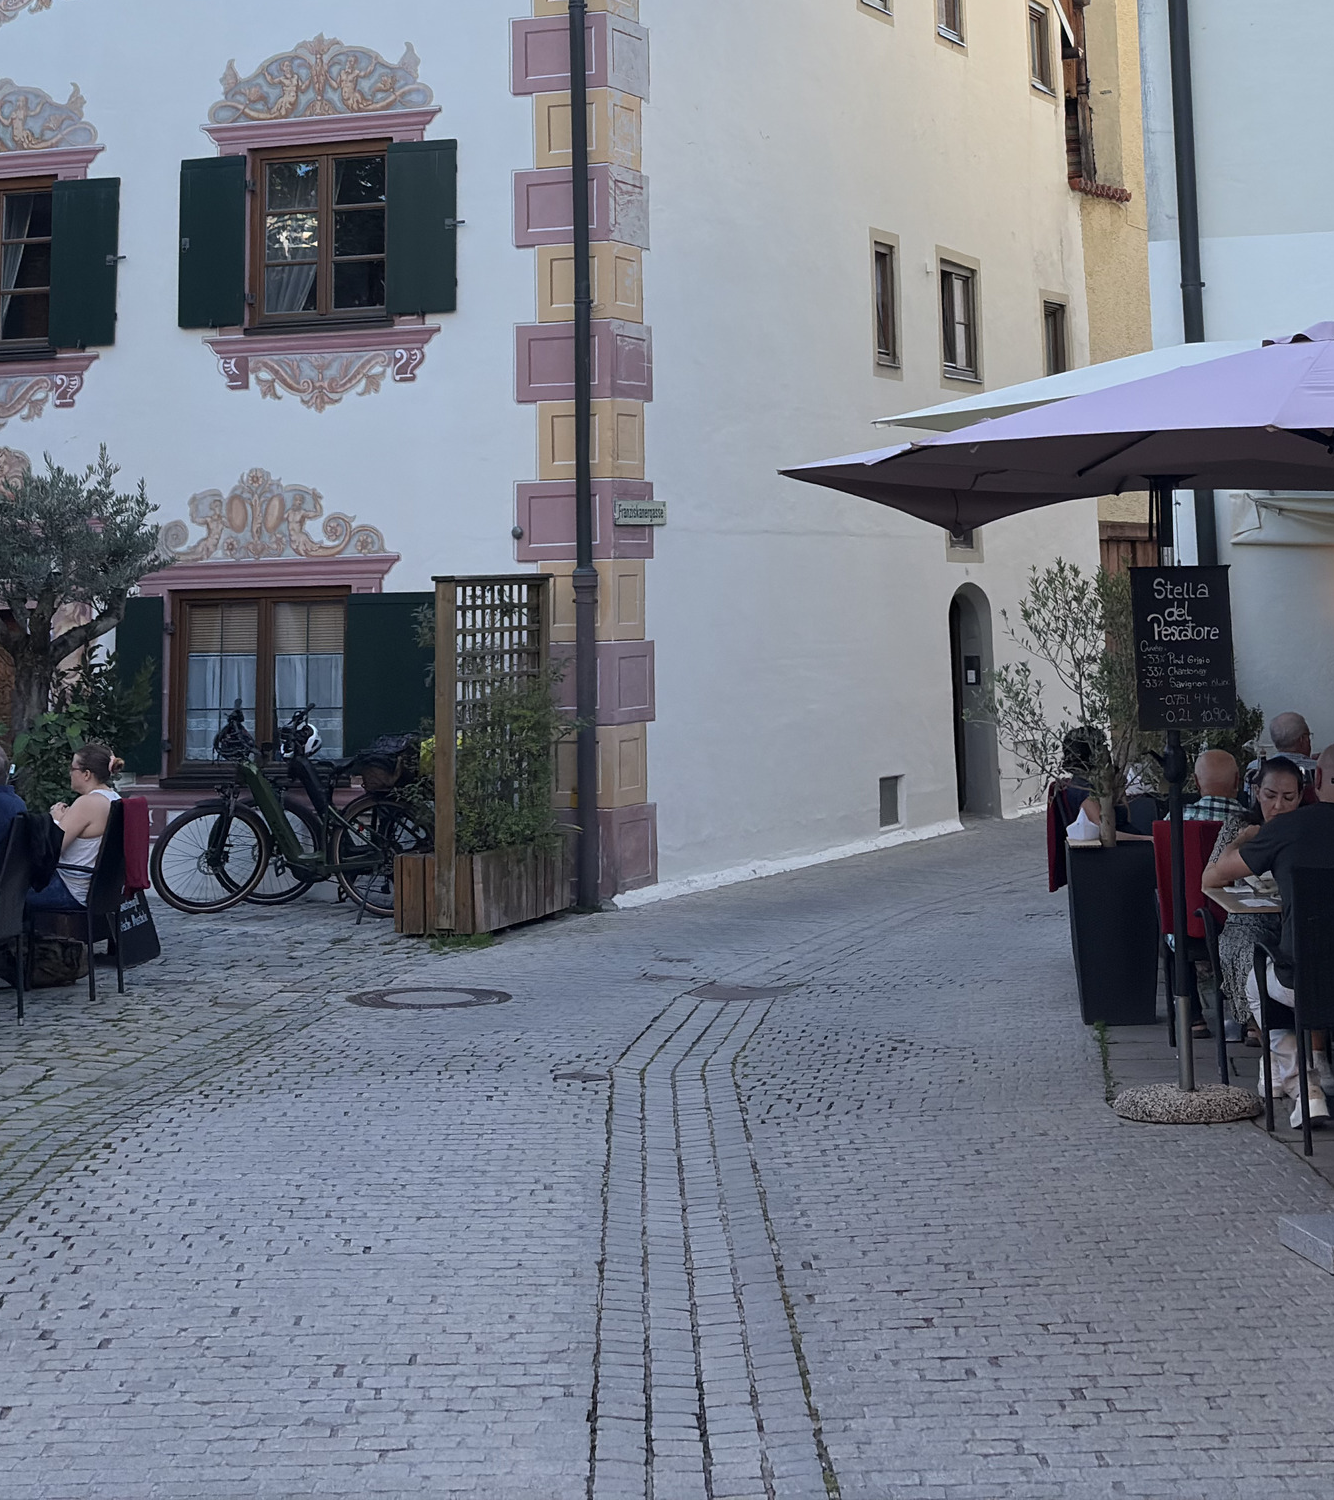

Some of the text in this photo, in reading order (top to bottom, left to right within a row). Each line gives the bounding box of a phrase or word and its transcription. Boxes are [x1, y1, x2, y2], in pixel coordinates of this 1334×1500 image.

[1153, 577, 1210, 600] Stella
[1164, 601, 1192, 621] del
[1147, 613, 1220, 641] Pescatore
